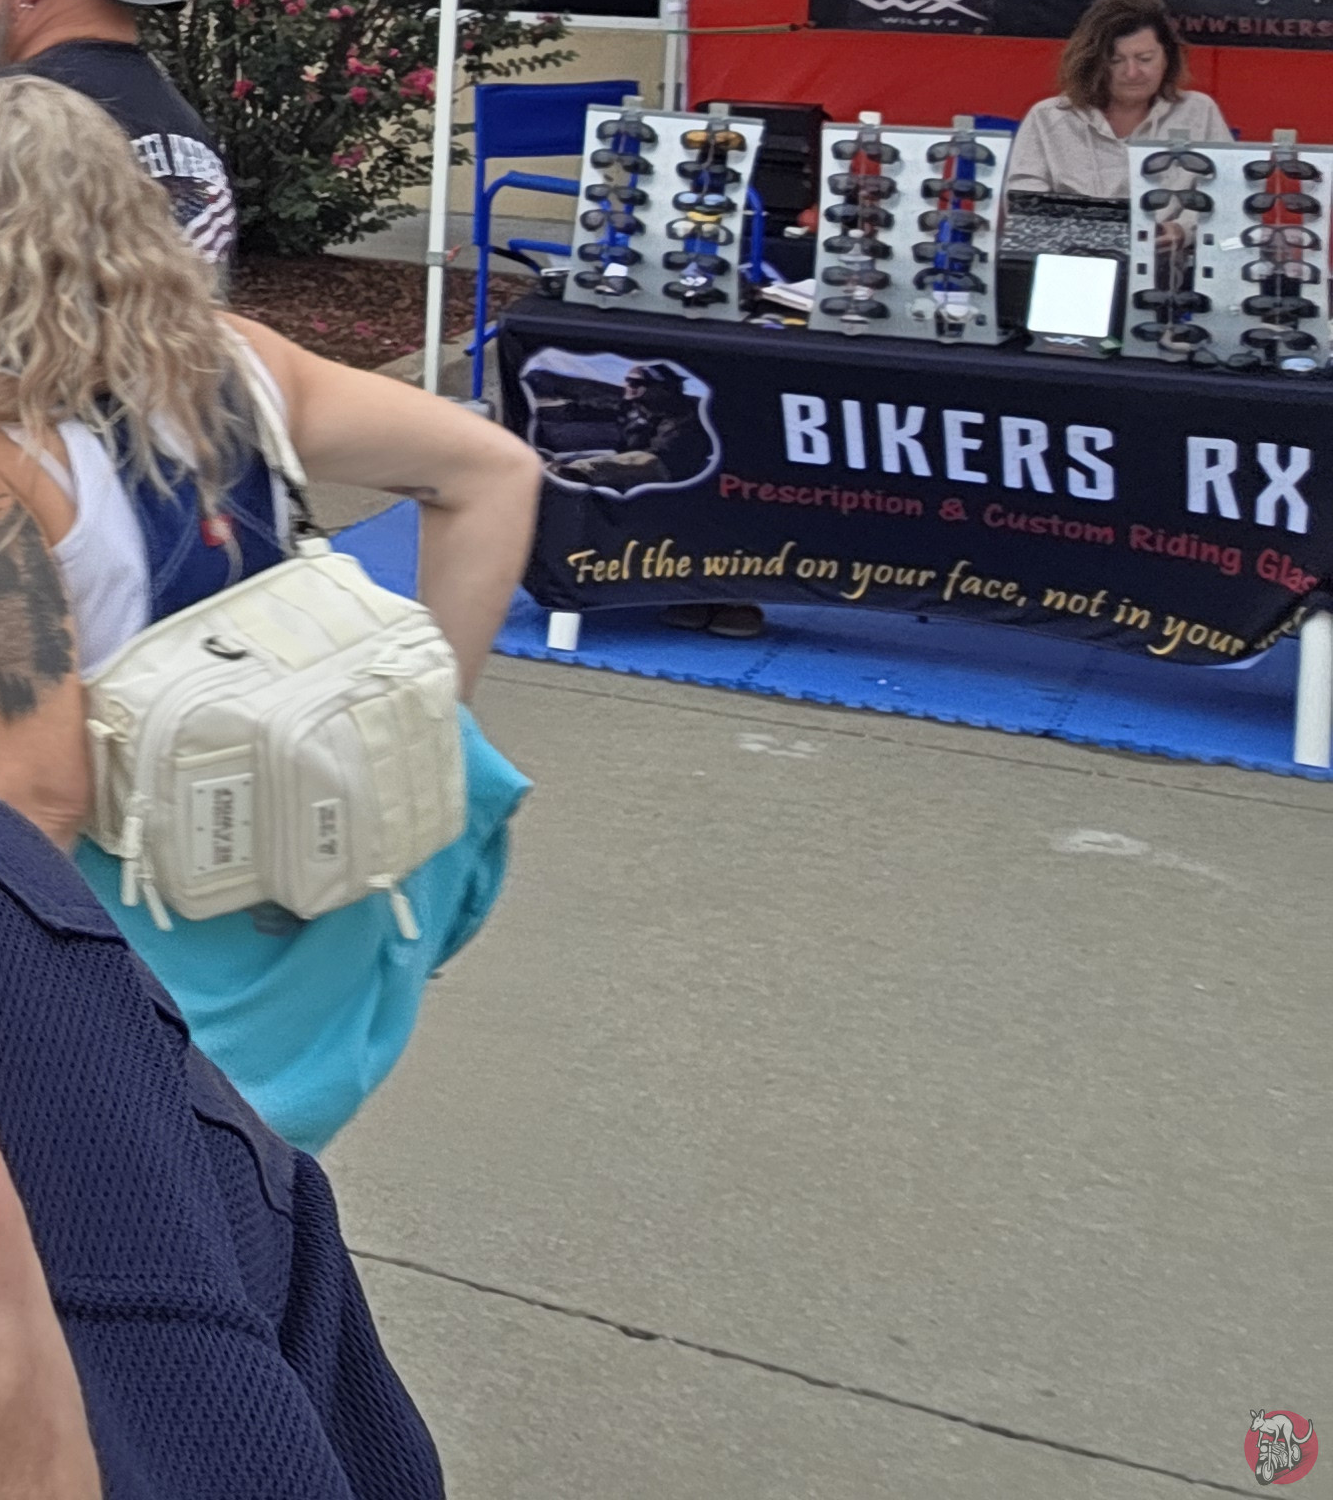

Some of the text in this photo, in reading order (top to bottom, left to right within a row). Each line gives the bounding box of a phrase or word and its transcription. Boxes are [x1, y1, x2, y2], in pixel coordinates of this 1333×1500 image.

[780, 392, 1312, 536] BIKERS RX
[718, 472, 924, 517] Prescription
[938, 497, 969, 522] &
[983, 503, 1116, 545] Custom
[1129, 523, 1242, 576] Riding
[566, 540, 640, 584] Feel
[641, 538, 693, 580] the
[703, 540, 797, 578] wind
[796, 556, 839, 580] on
[839, 560, 937, 600] your
[942, 559, 1028, 607] face,
[1041, 586, 1109, 618] not
[1113, 598, 1151, 630] in
[1147, 614, 1247, 656] your
